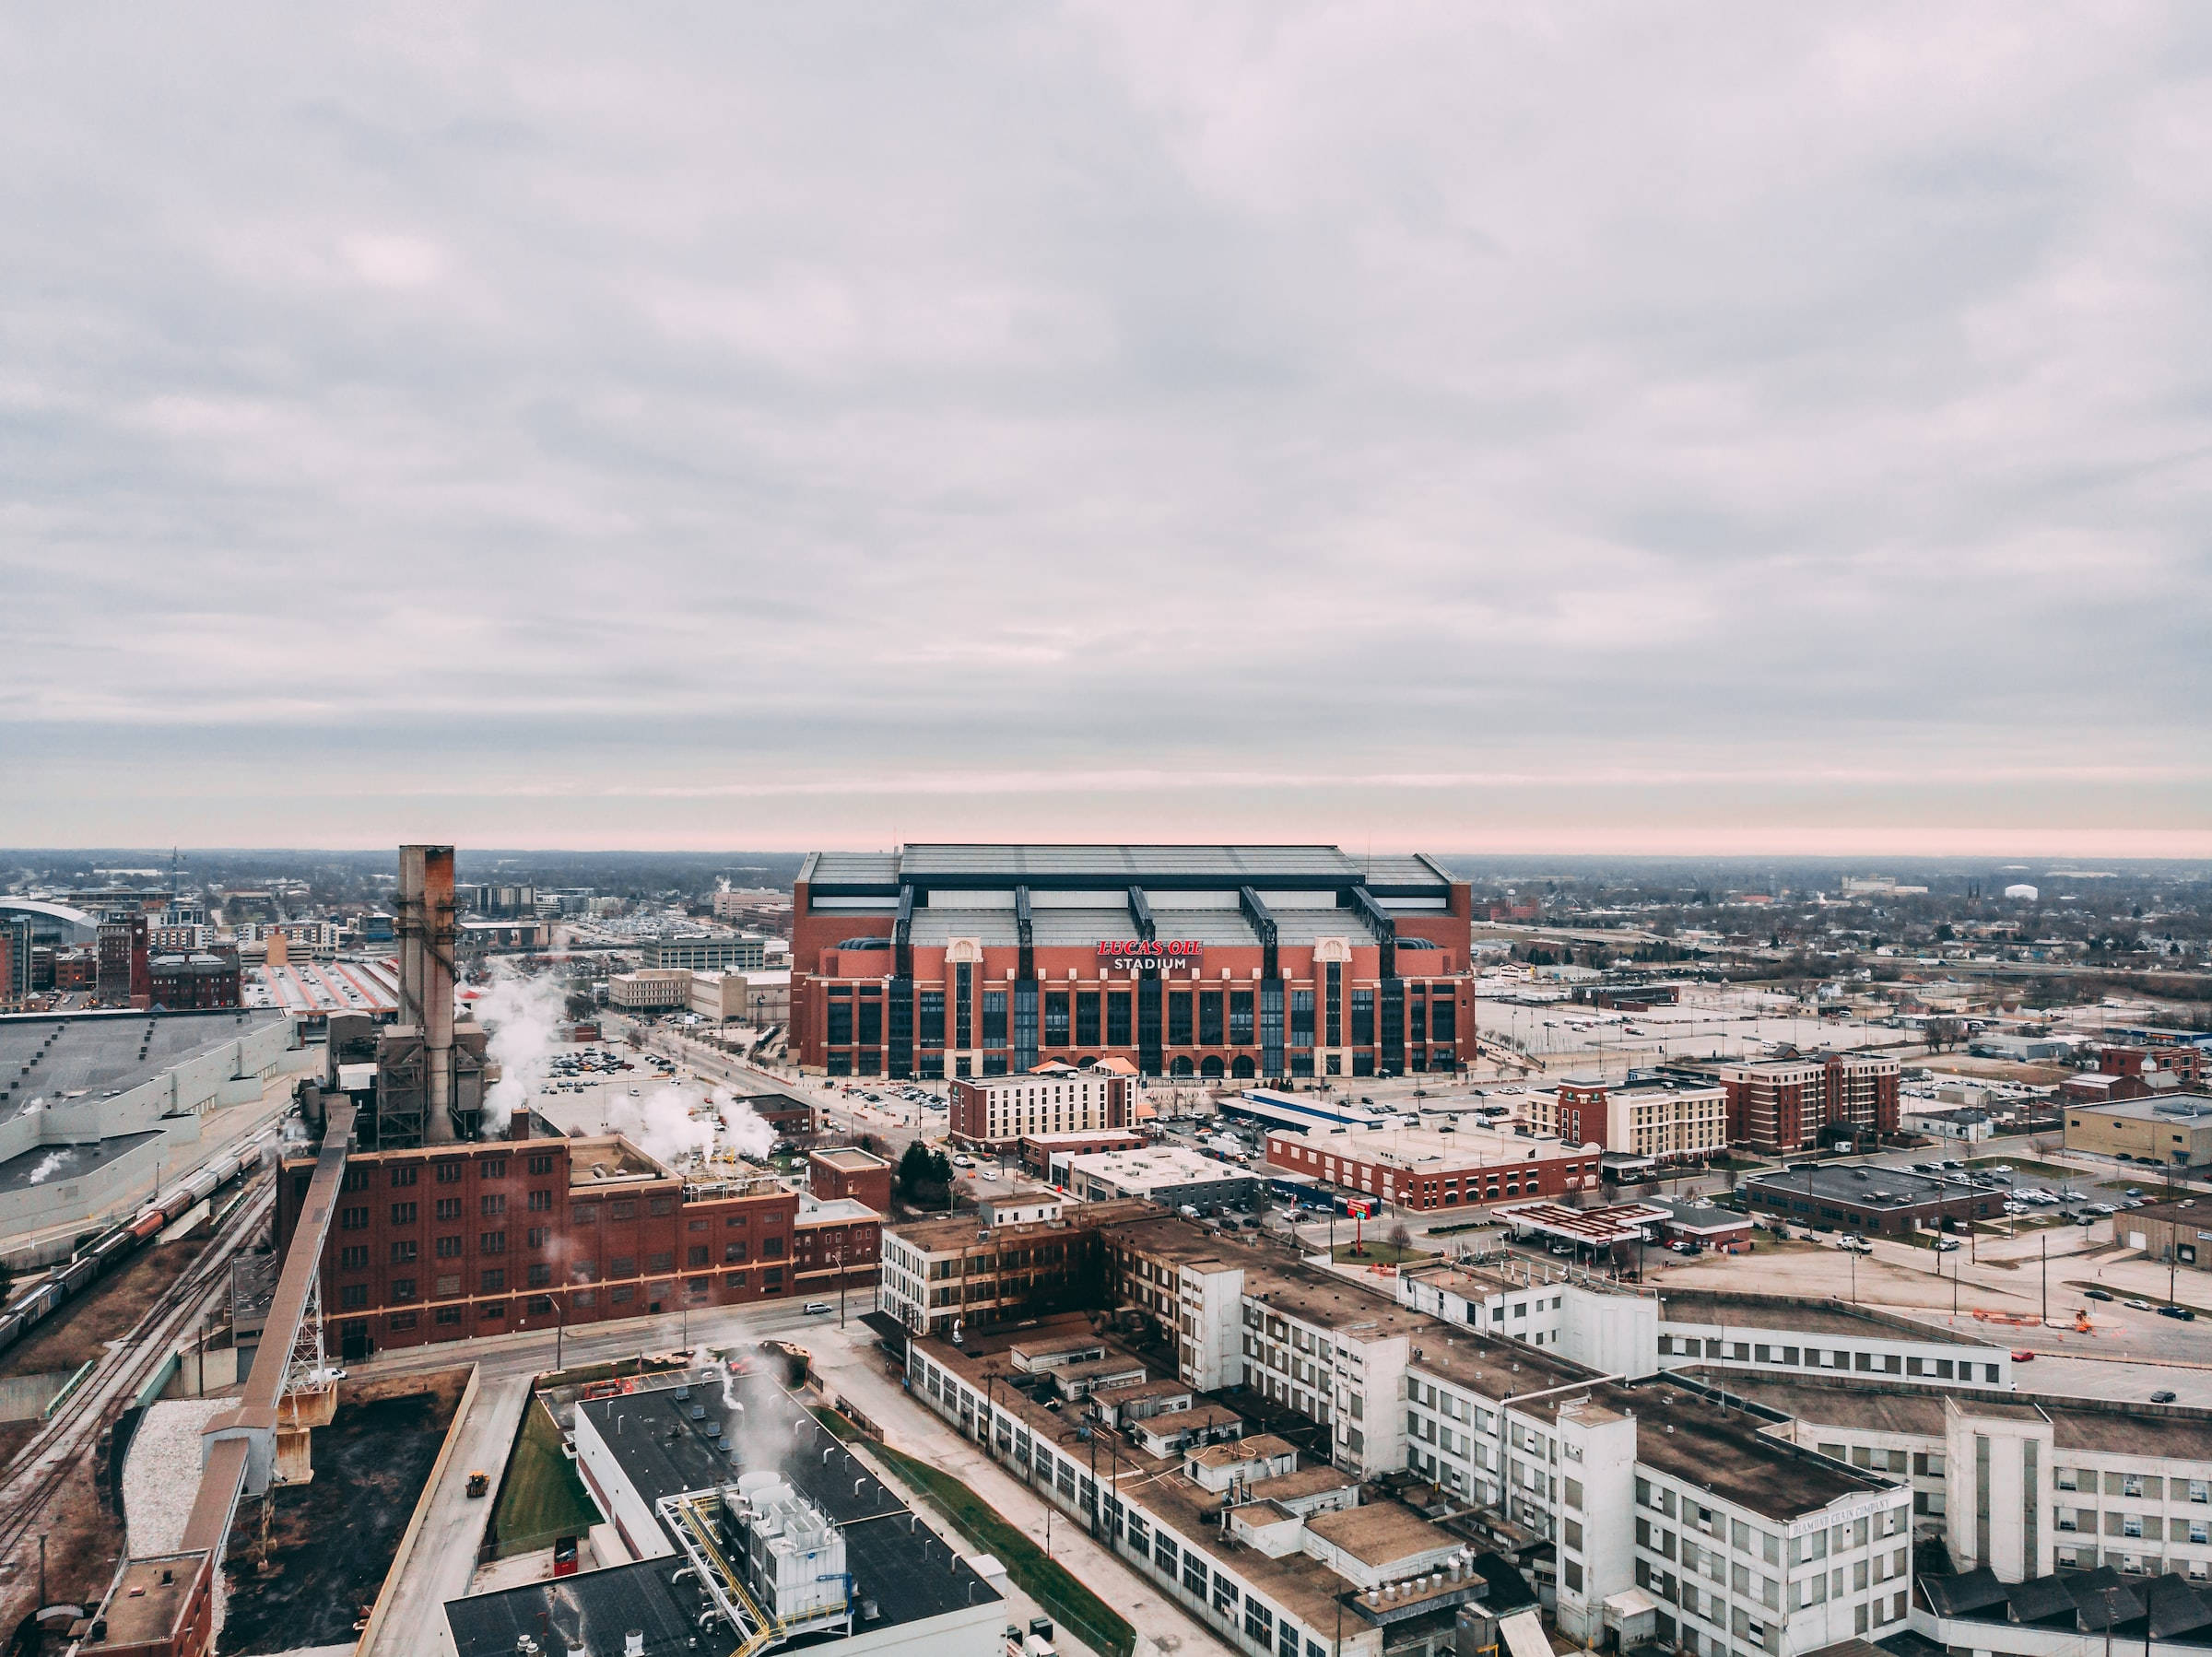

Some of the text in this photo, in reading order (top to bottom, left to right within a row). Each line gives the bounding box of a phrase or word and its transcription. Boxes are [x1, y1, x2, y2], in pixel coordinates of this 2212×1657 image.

[1098, 940, 1203, 955] LUCAS OIL
[1114, 958, 1186, 970] STADIUM
[1793, 1499, 1889, 1535] DIAMOND CHAIN COMPANY
